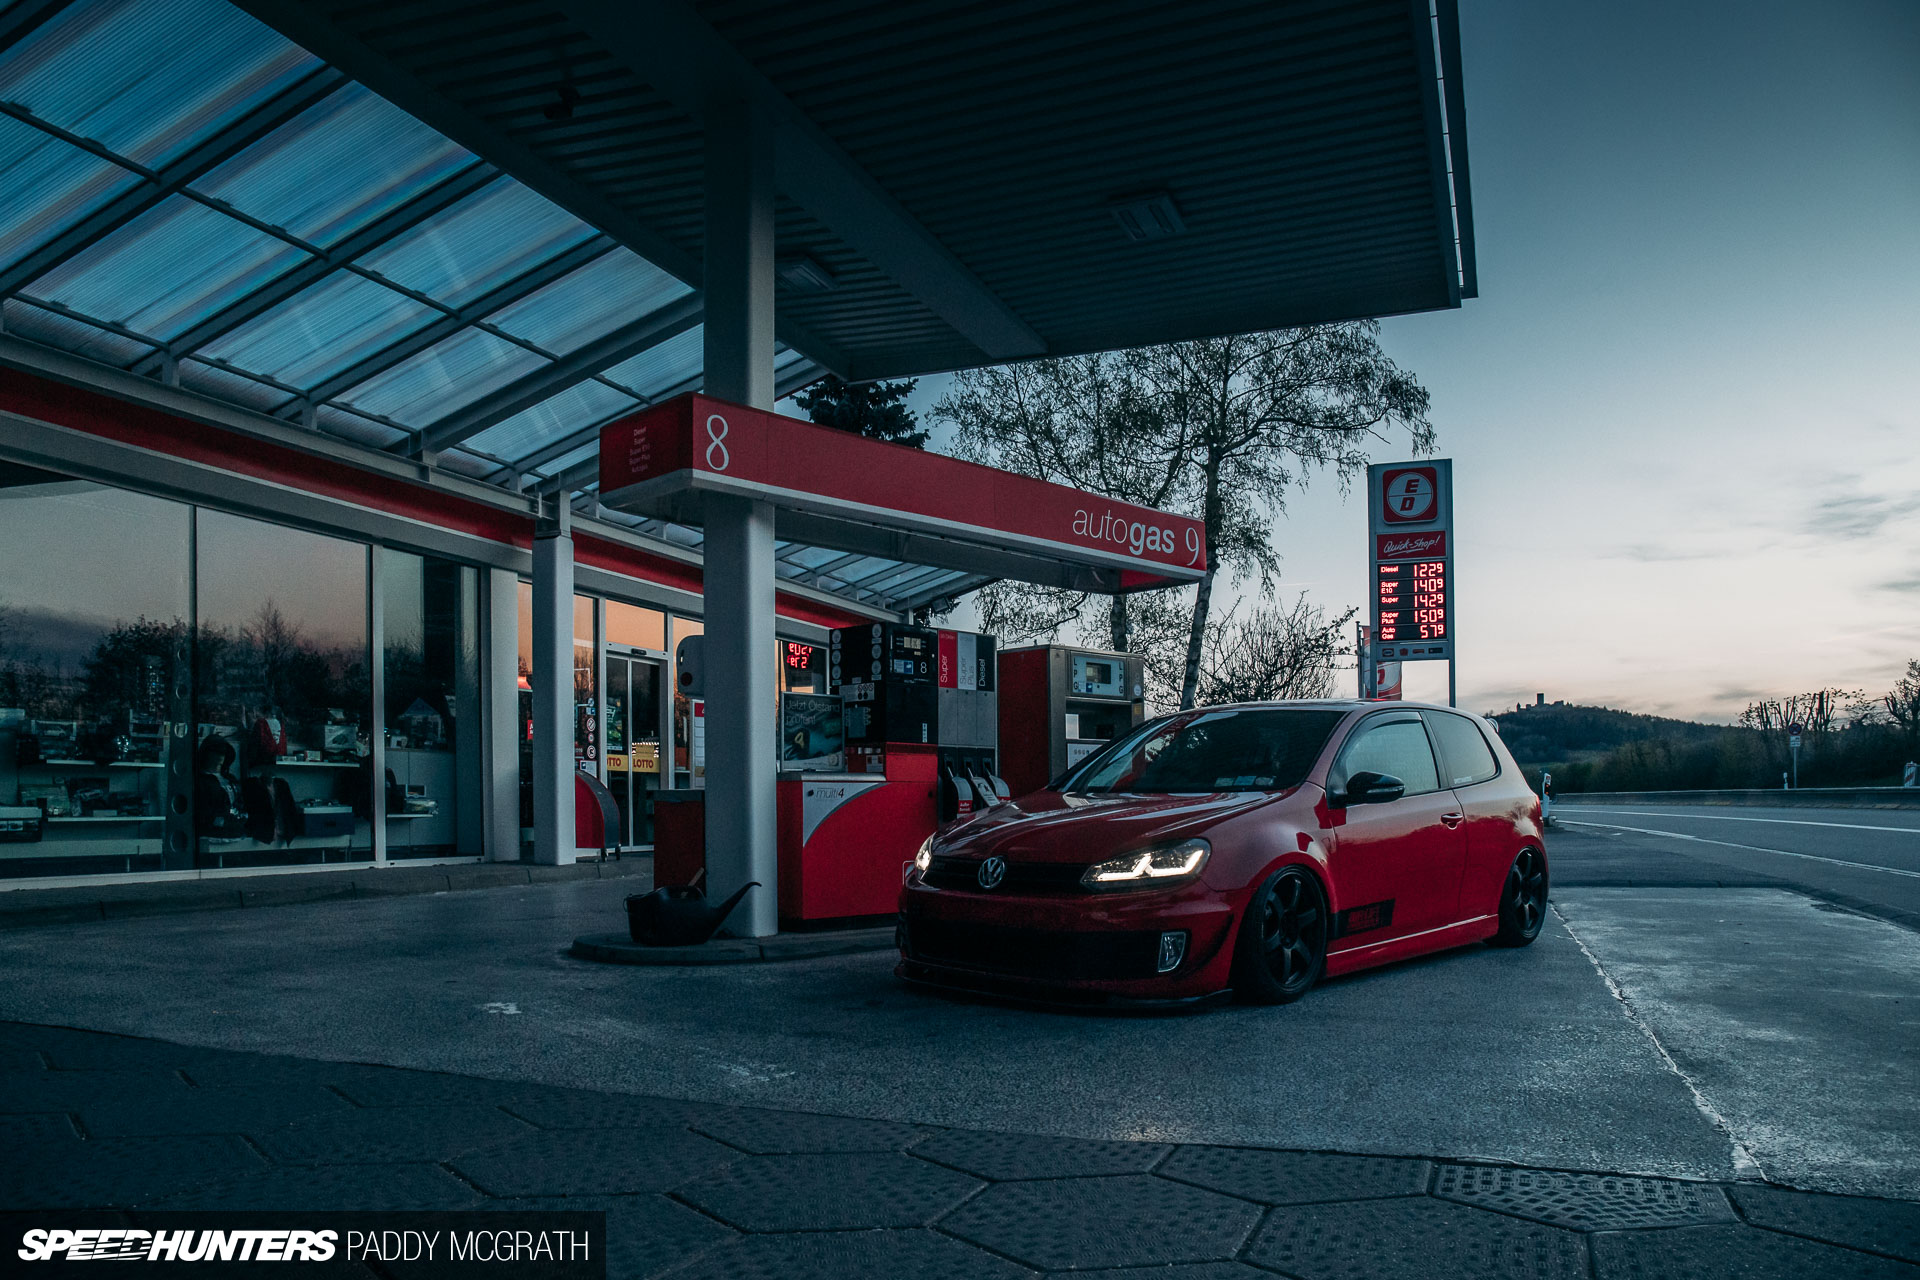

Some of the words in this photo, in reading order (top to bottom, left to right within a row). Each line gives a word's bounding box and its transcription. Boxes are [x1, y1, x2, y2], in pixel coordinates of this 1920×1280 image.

[705, 414, 730, 471] 8
[1072, 509, 1175, 555] autogas
[1185, 527, 1200, 566] 9
[920, 661, 927, 674] 8
[940, 654, 948, 683] Super
[960, 657, 968, 684] Super
[978, 658, 986, 687] Diesel
[785, 700, 806, 710] Jetzt
[632, 758, 654, 769] LOTTO
